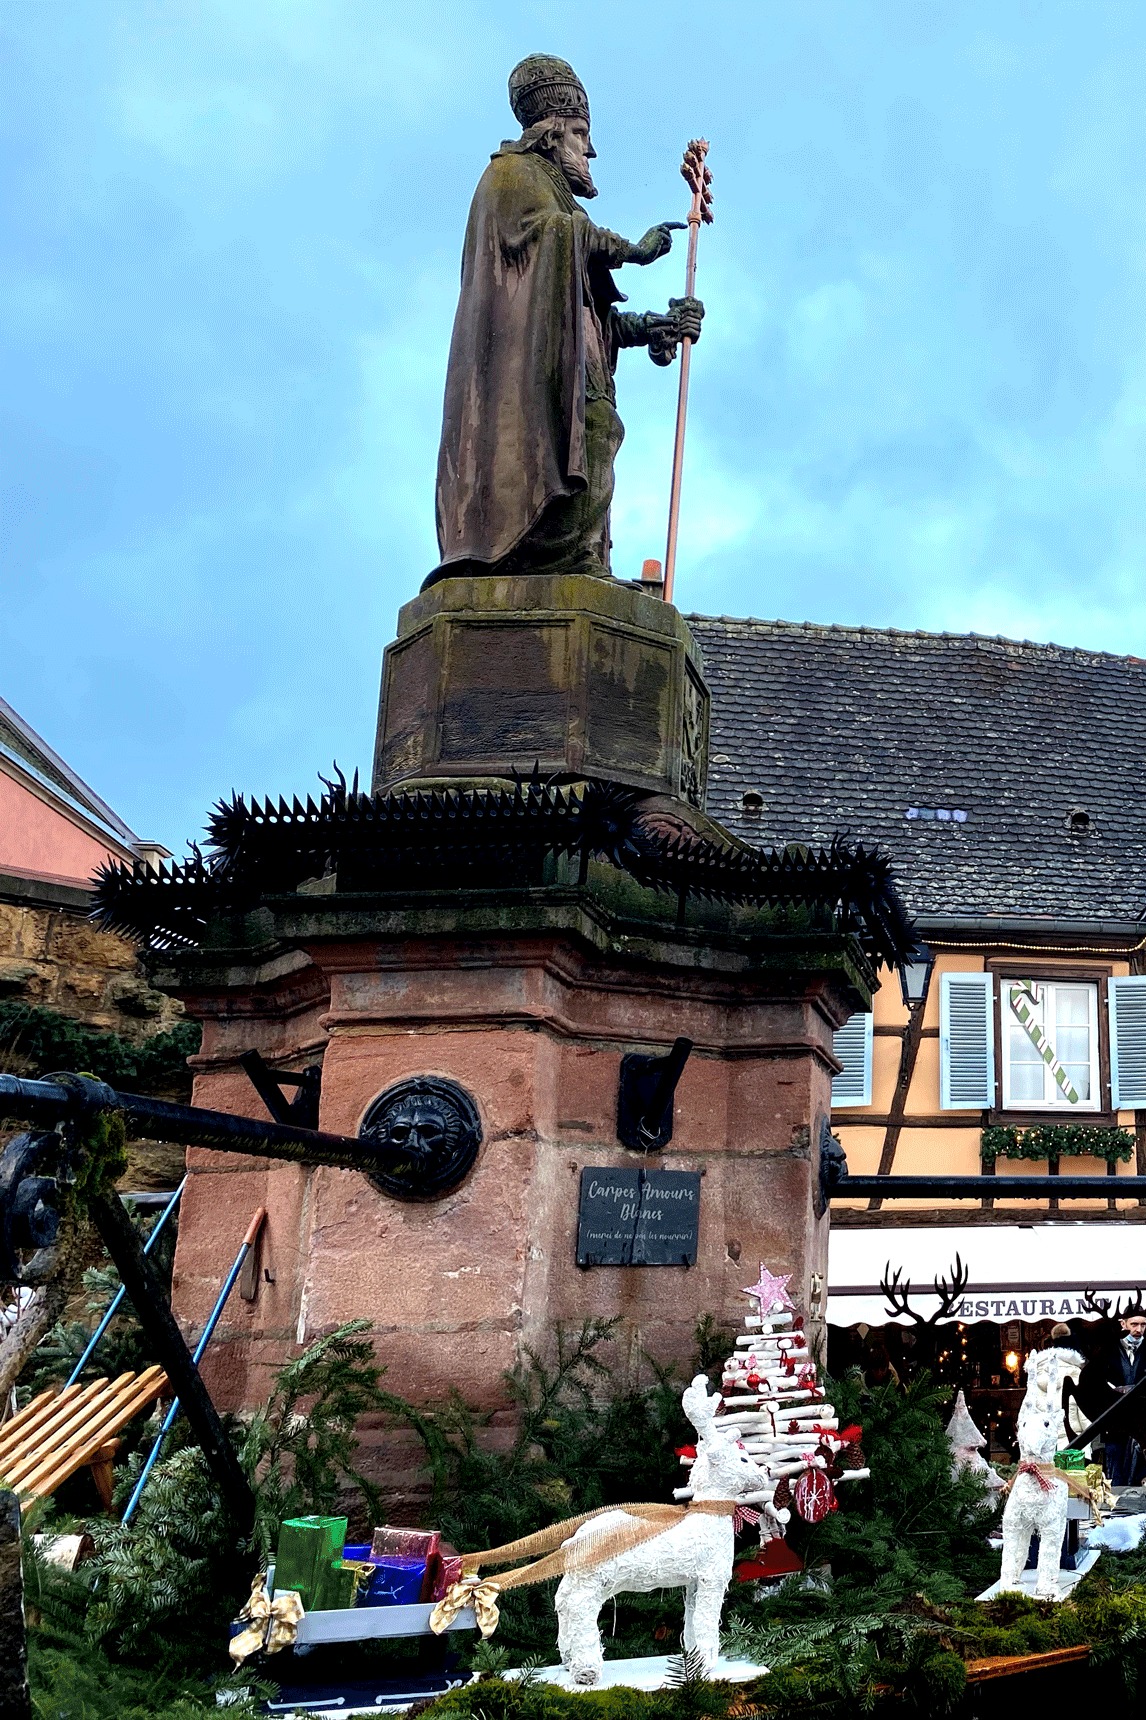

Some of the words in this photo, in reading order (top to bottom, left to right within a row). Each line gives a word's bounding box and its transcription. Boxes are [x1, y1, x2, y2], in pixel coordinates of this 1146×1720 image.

[588, 1180, 637, 1203] Carpes
[642, 1182, 695, 1201] Amours
[620, 1203, 664, 1221] Blancs
[614, 1229, 623, 1240] de
